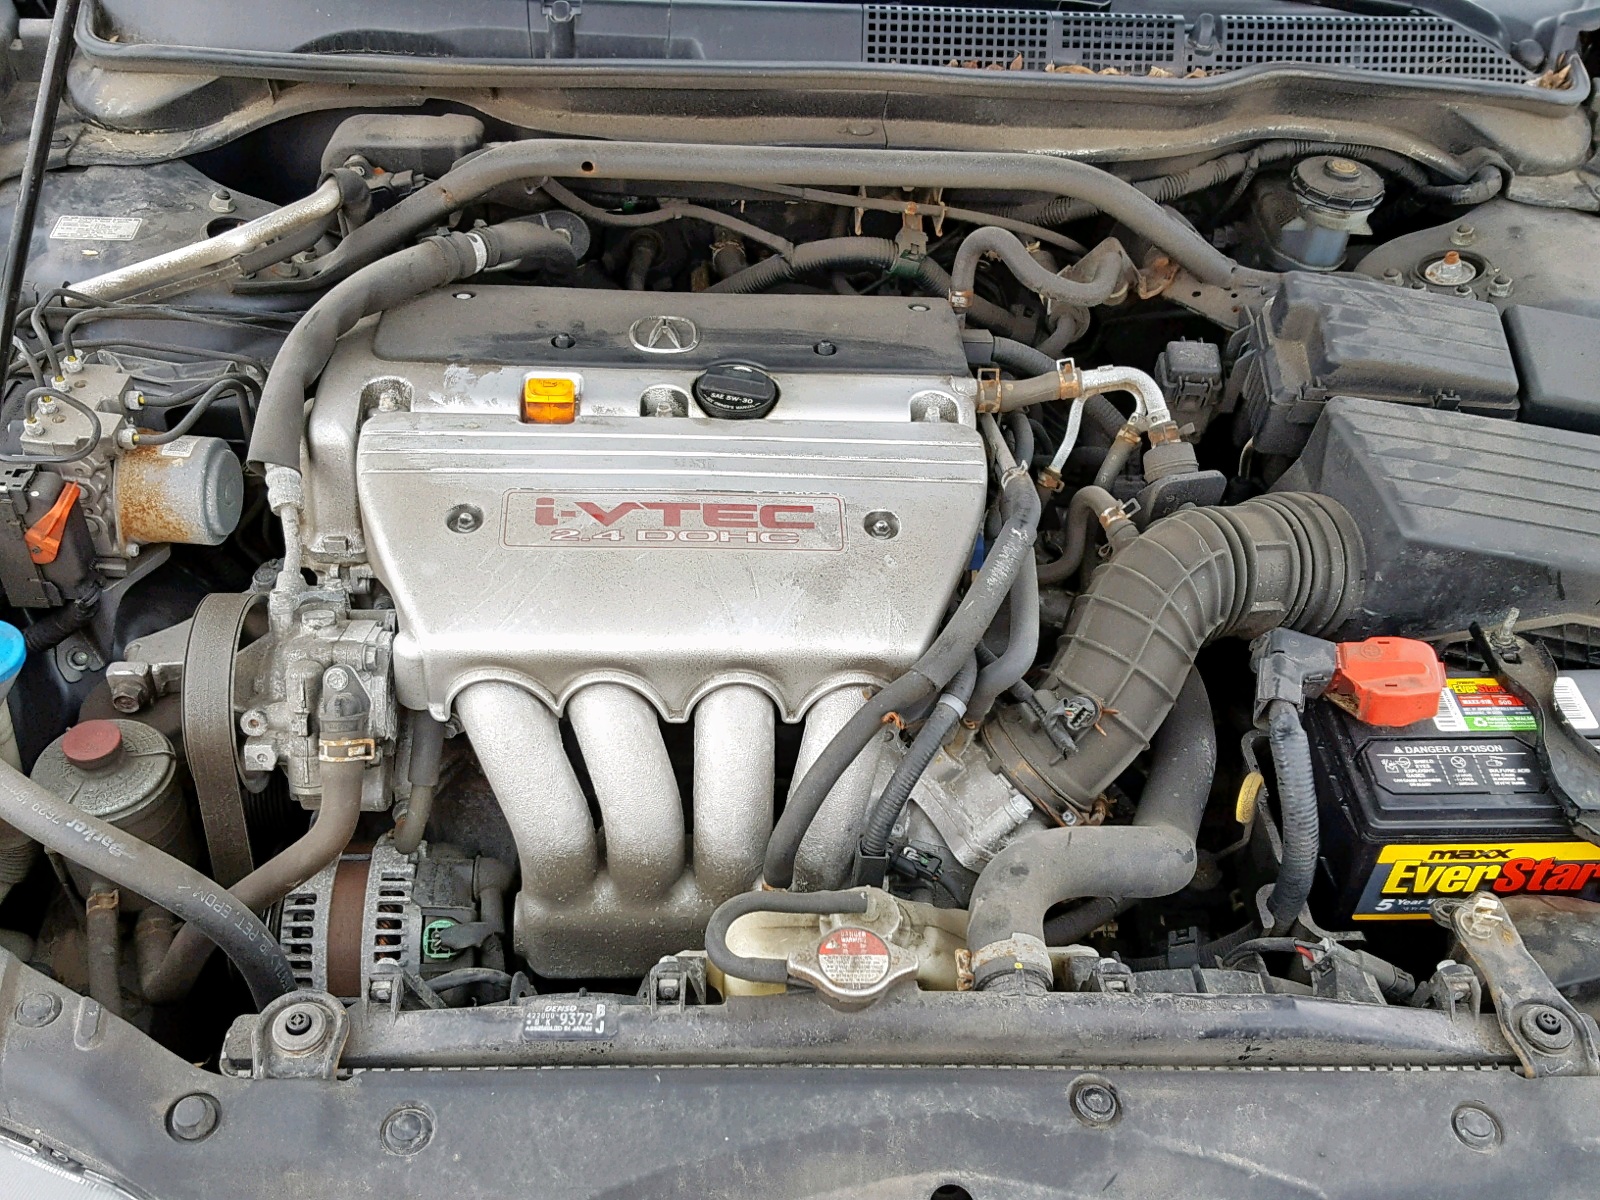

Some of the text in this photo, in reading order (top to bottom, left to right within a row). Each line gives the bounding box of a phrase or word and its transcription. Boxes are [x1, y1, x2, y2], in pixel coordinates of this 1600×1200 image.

[711, 392, 753, 404] SAE 5W-30
[535, 497, 815, 529] i-VTEC
[551, 529, 799, 544] 2.4 DOHC
[1405, 746, 1449, 754] DANGER
[65, 819, 126, 857] Parker
[1428, 848, 1514, 860] maxx
[1375, 899, 1396, 911] 5
